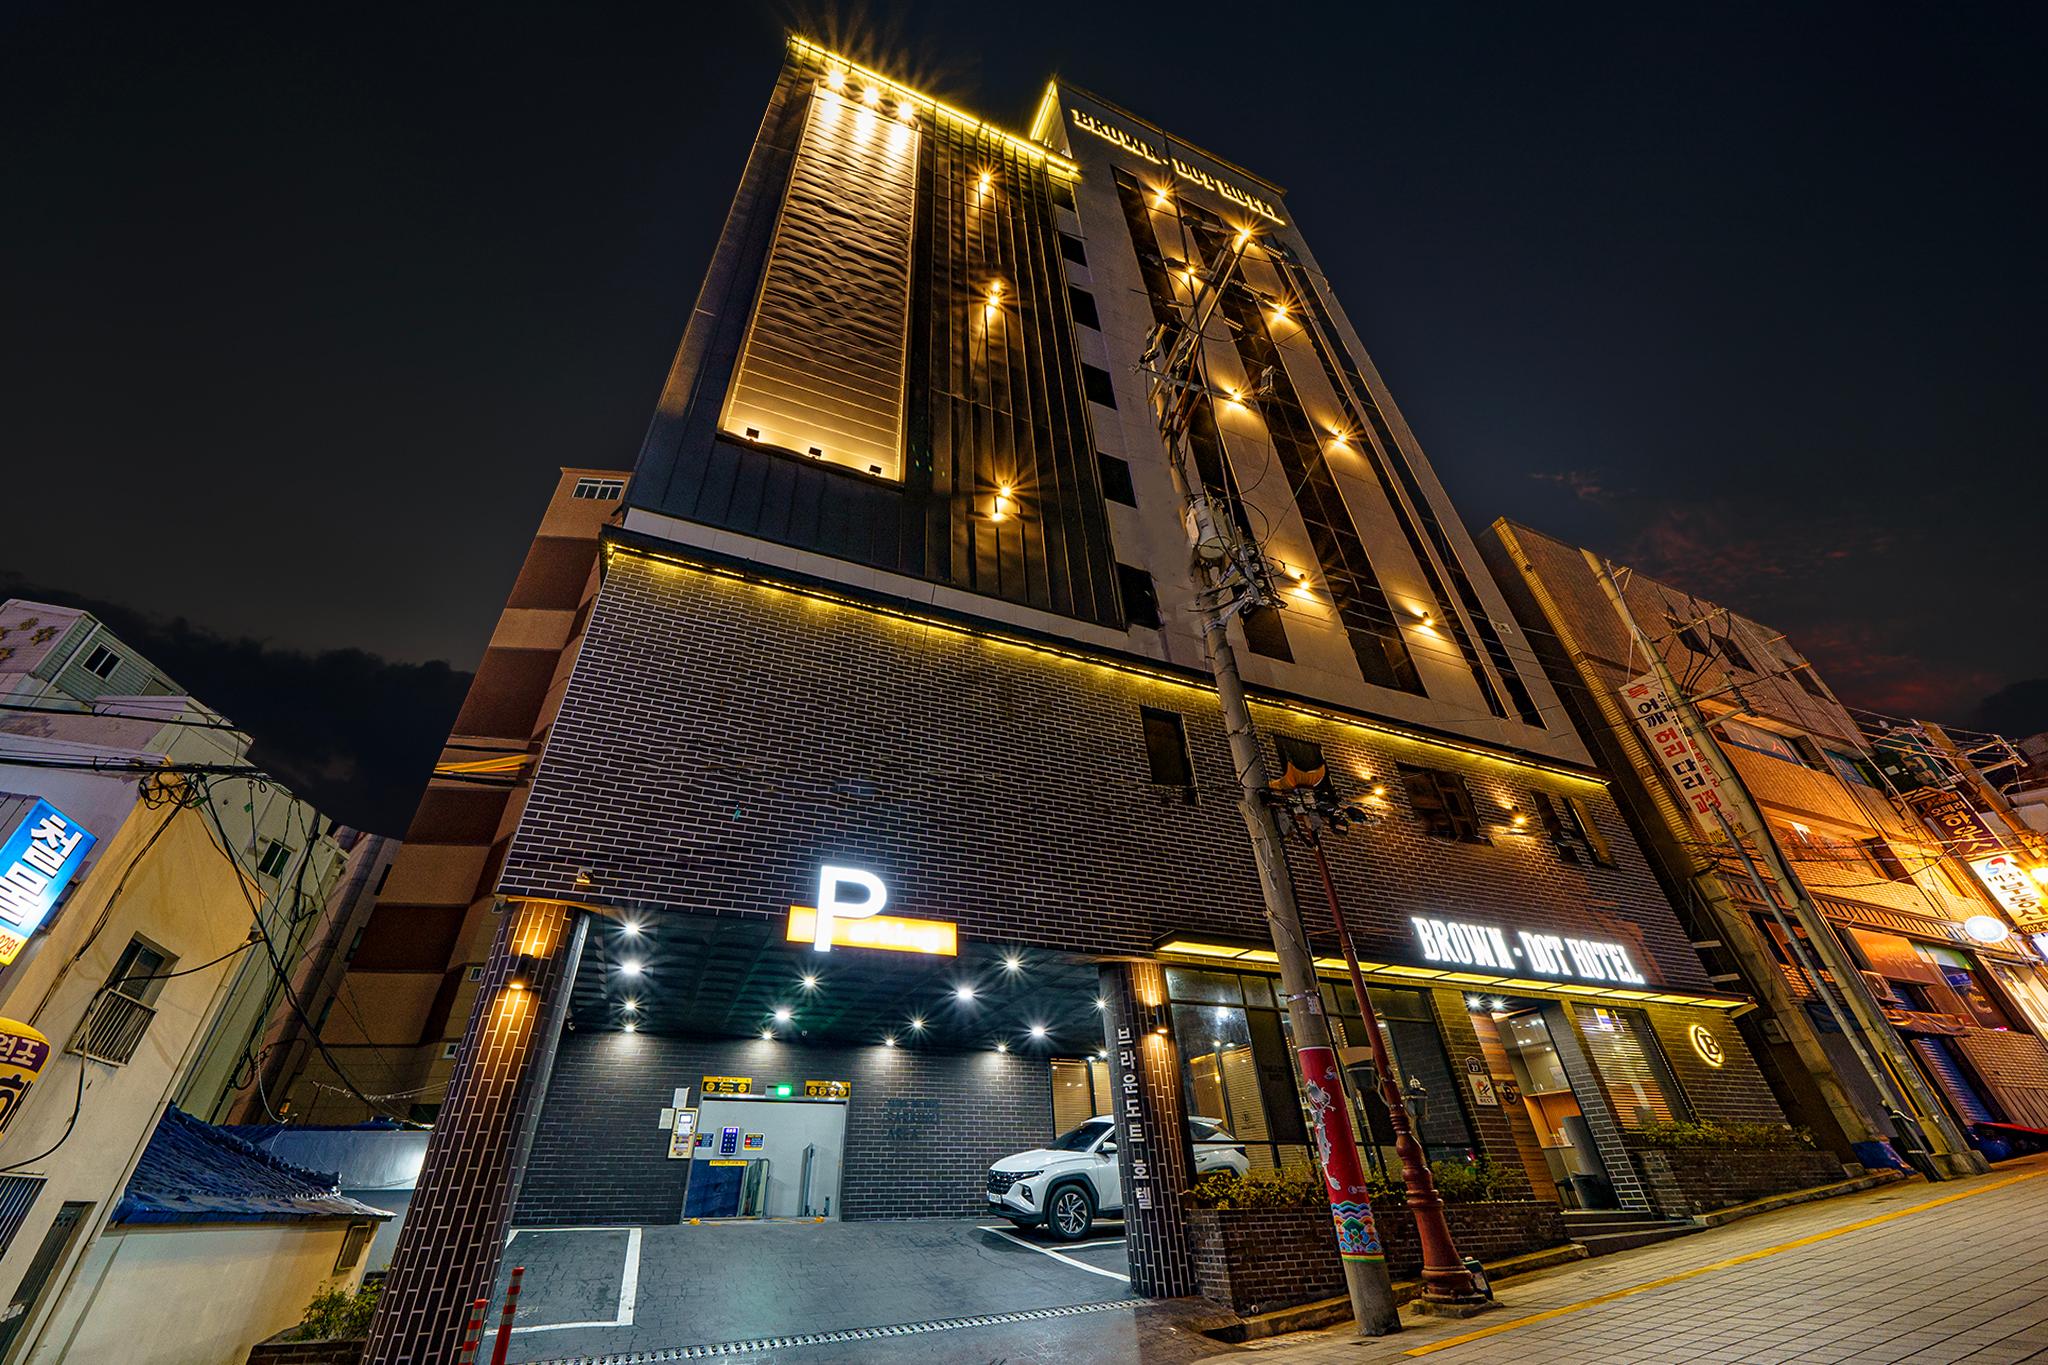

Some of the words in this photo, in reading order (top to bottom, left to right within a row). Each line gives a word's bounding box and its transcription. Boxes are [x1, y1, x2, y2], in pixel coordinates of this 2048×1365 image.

[1638, 697, 1669, 728] 어깨
[1654, 726, 1688, 758] 허리
[1672, 758, 1706, 790] 다리
[0, 813, 84, 926] 철물
[1940, 810, 1994, 852] 하우스
[1411, 916, 1516, 970] BROWN
[1517, 930, 1573, 977] DOT
[1564, 938, 1646, 985] HOTEL
[1117, 1027, 1145, 1142] 브라운도트
[1132, 1158, 1153, 1210] 호텔
